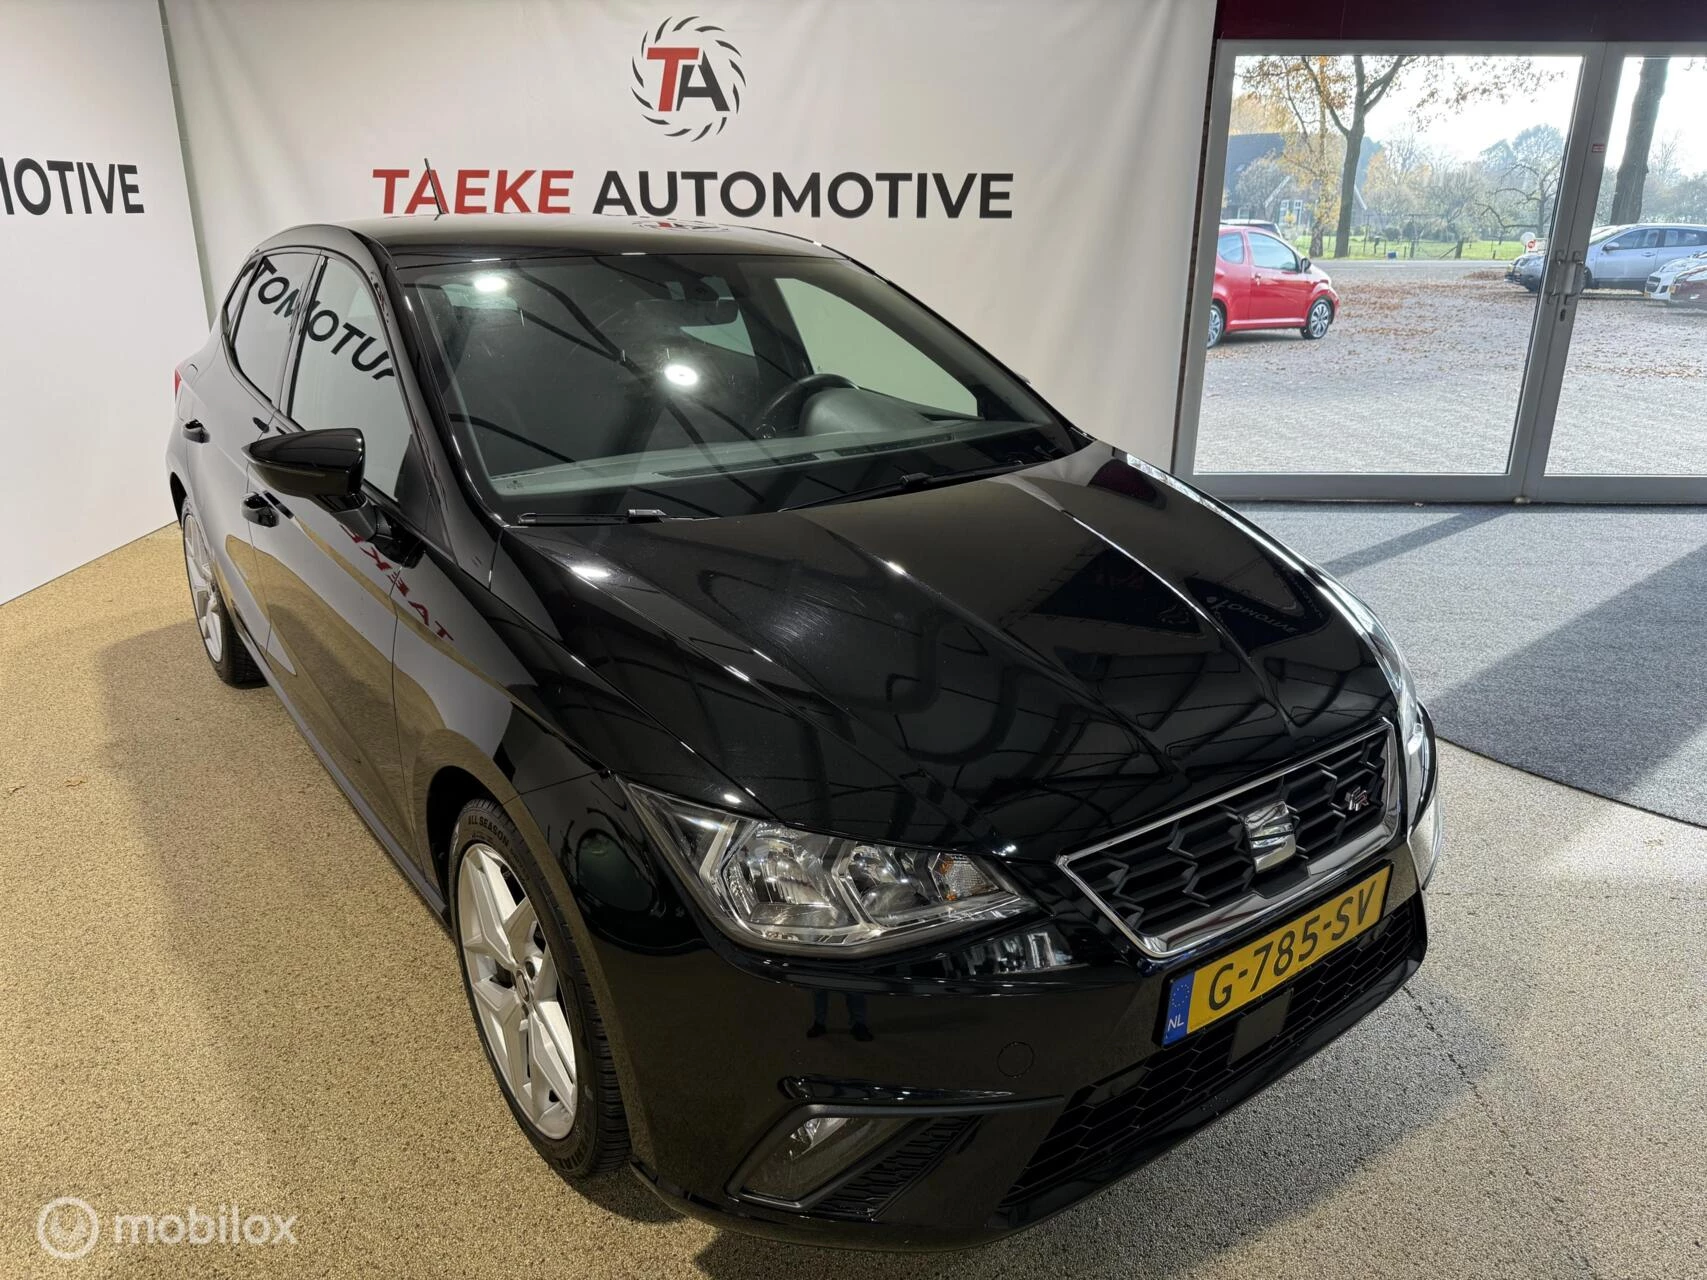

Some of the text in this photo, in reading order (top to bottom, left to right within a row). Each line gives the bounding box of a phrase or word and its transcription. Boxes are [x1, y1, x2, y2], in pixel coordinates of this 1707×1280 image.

[647, 47, 731, 112] TA
[373, 169, 1013, 219] TAEKE AUTOMOTIVE
[479, 816, 510, 847] SEASON
[1208, 880, 1377, 1011] G-785-SV
[1167, 1014, 1185, 1031] NL
